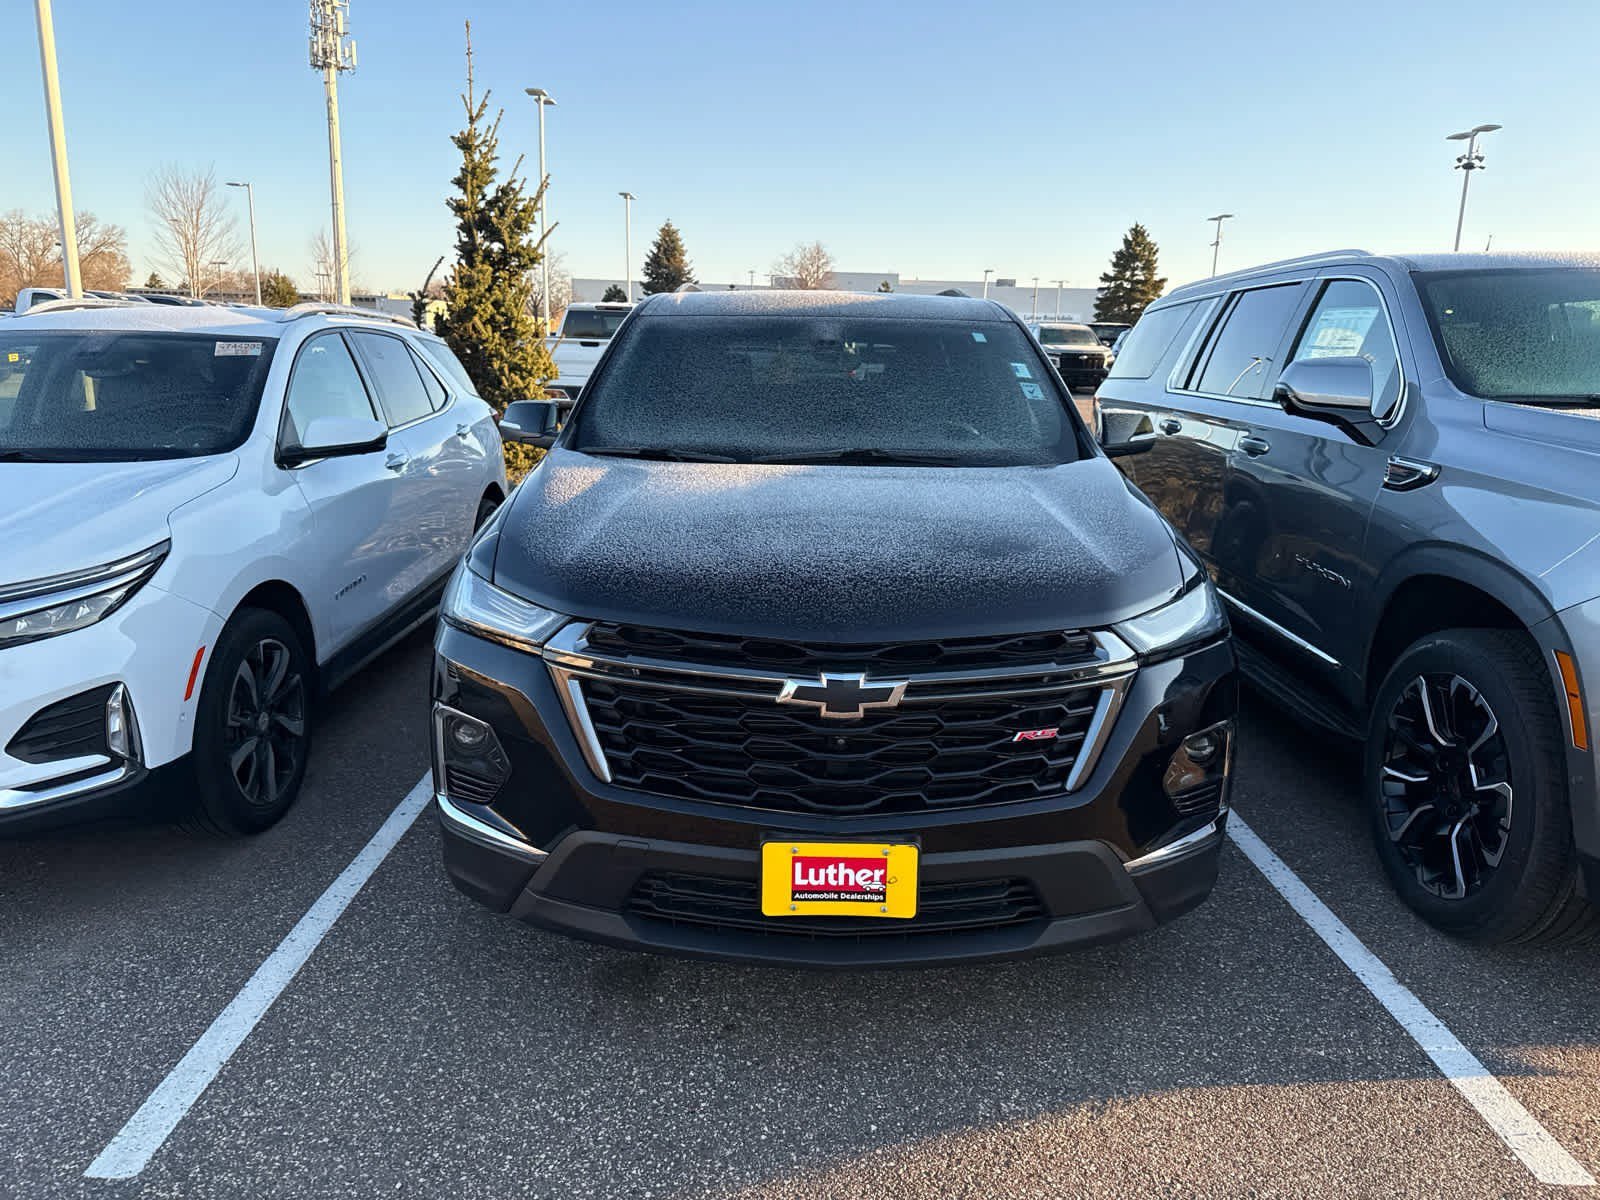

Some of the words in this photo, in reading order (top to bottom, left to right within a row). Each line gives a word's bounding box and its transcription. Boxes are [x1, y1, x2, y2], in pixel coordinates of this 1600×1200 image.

[1012, 728, 1059, 742] RS
[794, 862, 885, 887] Luther
[794, 892, 838, 900] Automobile
[840, 892, 884, 902] Dealerships
